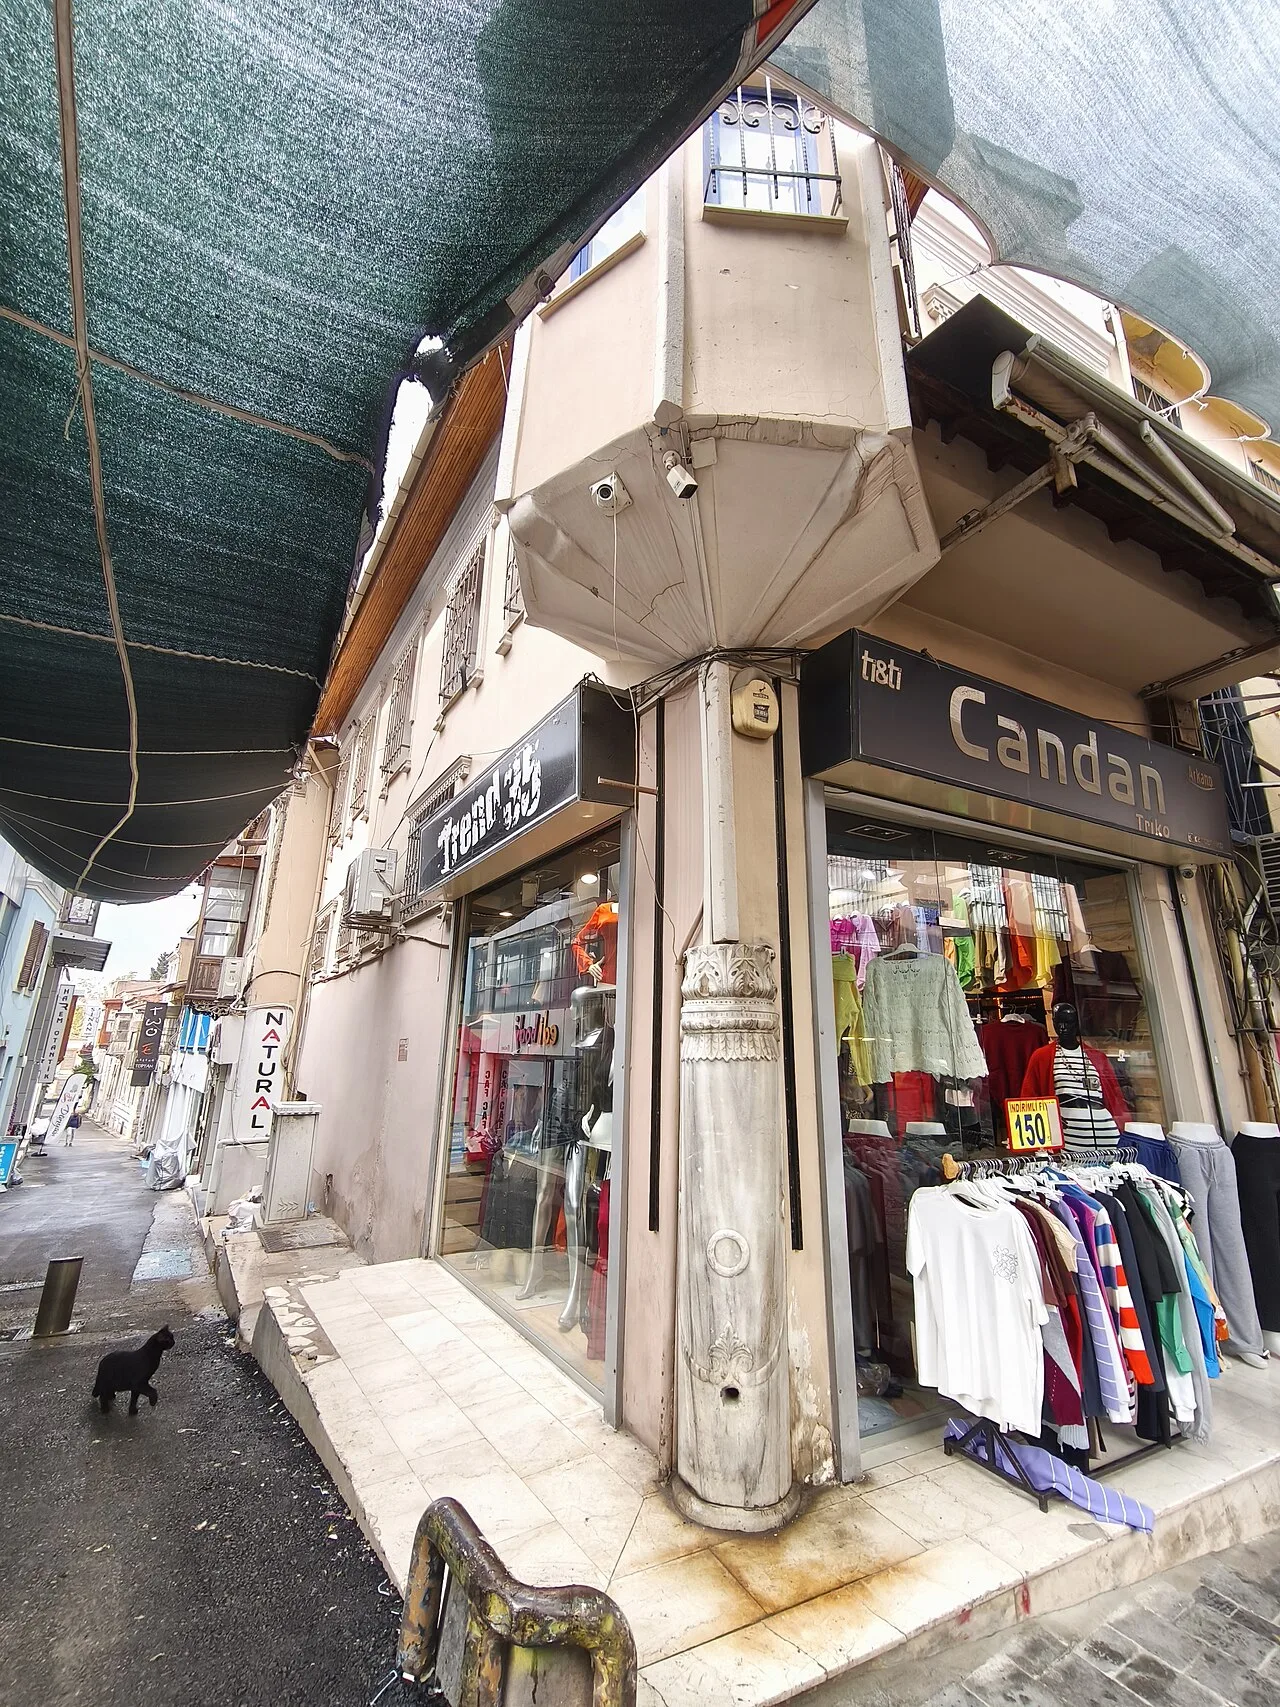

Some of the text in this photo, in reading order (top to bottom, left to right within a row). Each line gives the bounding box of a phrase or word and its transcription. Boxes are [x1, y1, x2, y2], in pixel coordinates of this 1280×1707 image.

[861, 649, 902, 690] ti&ti
[950, 685, 1166, 815] Candan
[437, 768, 502, 876] Trend
[1135, 813, 1170, 839] Triko
[57, 988, 70, 1024] HAREM
[251, 1011, 284, 1129] NATURAL
[1015, 1112, 1046, 1146] 150
